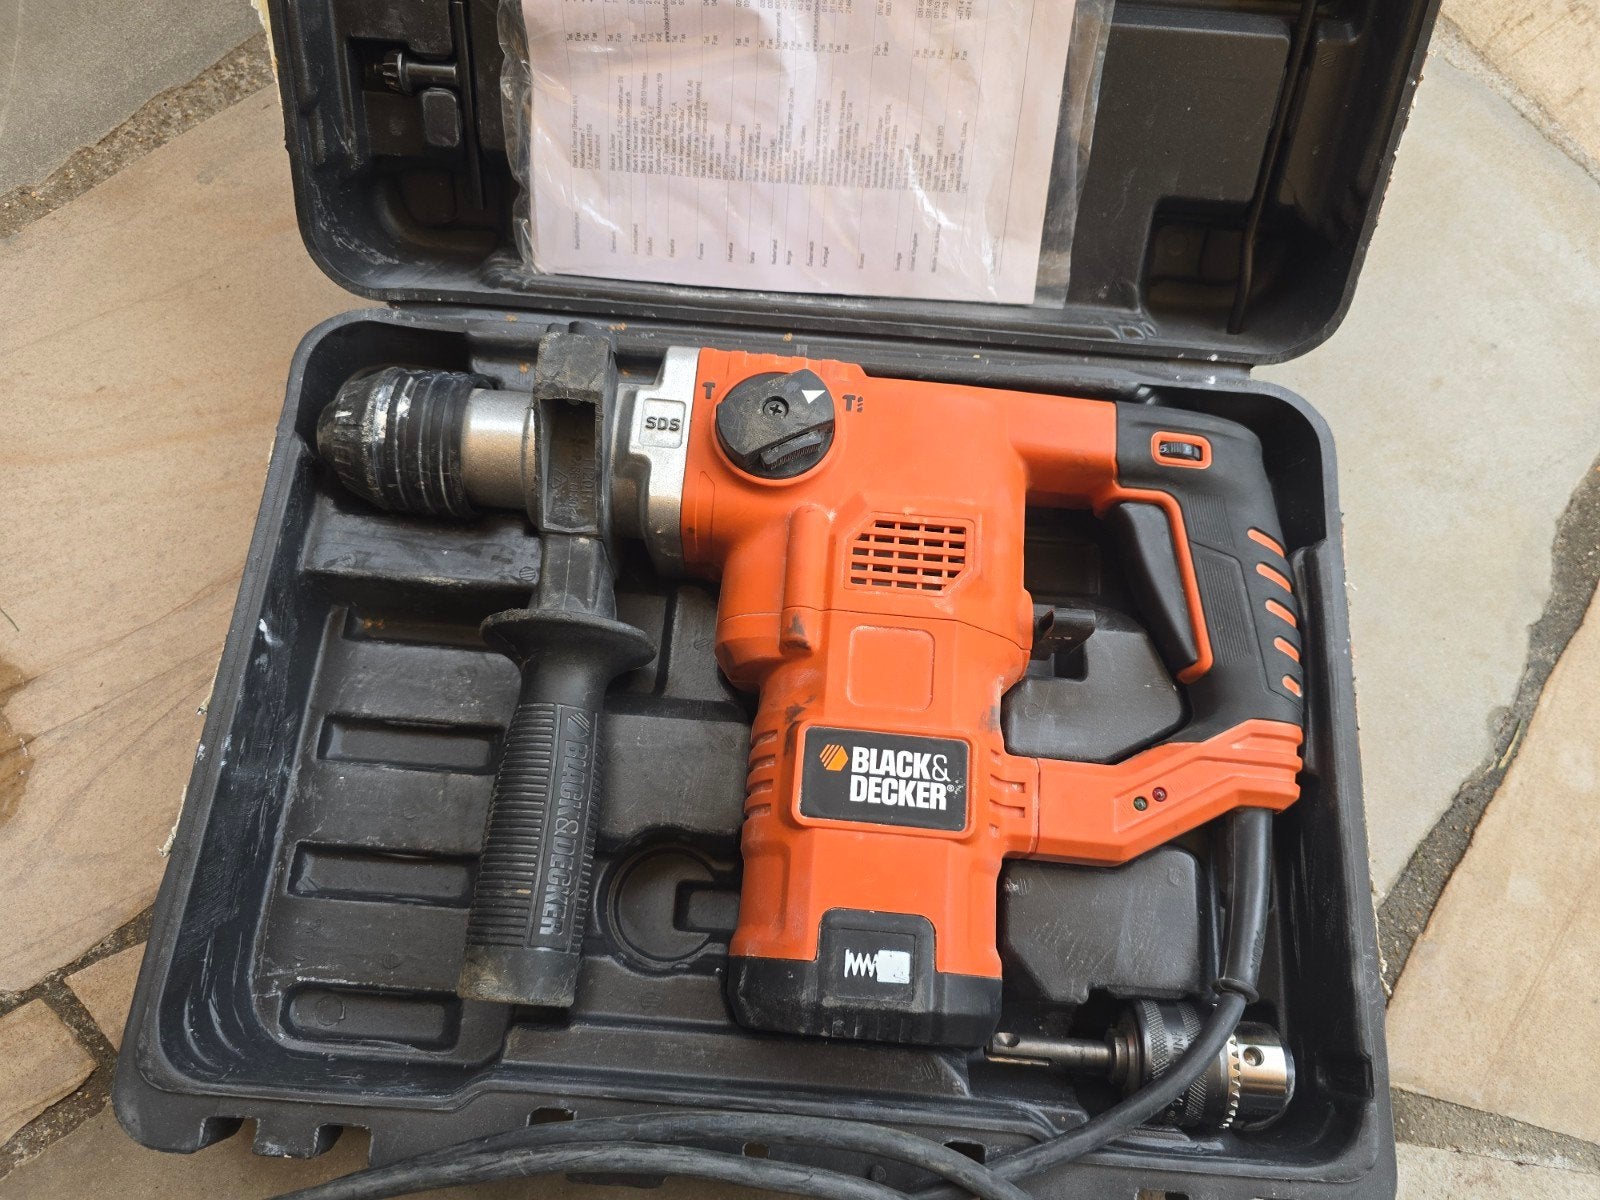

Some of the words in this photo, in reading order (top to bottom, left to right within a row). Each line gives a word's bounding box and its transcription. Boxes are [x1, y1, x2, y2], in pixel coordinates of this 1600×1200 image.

[645, 416, 681, 432] SDS
[557, 740, 588, 816] BLACK
[540, 836, 577, 936] DECKER
